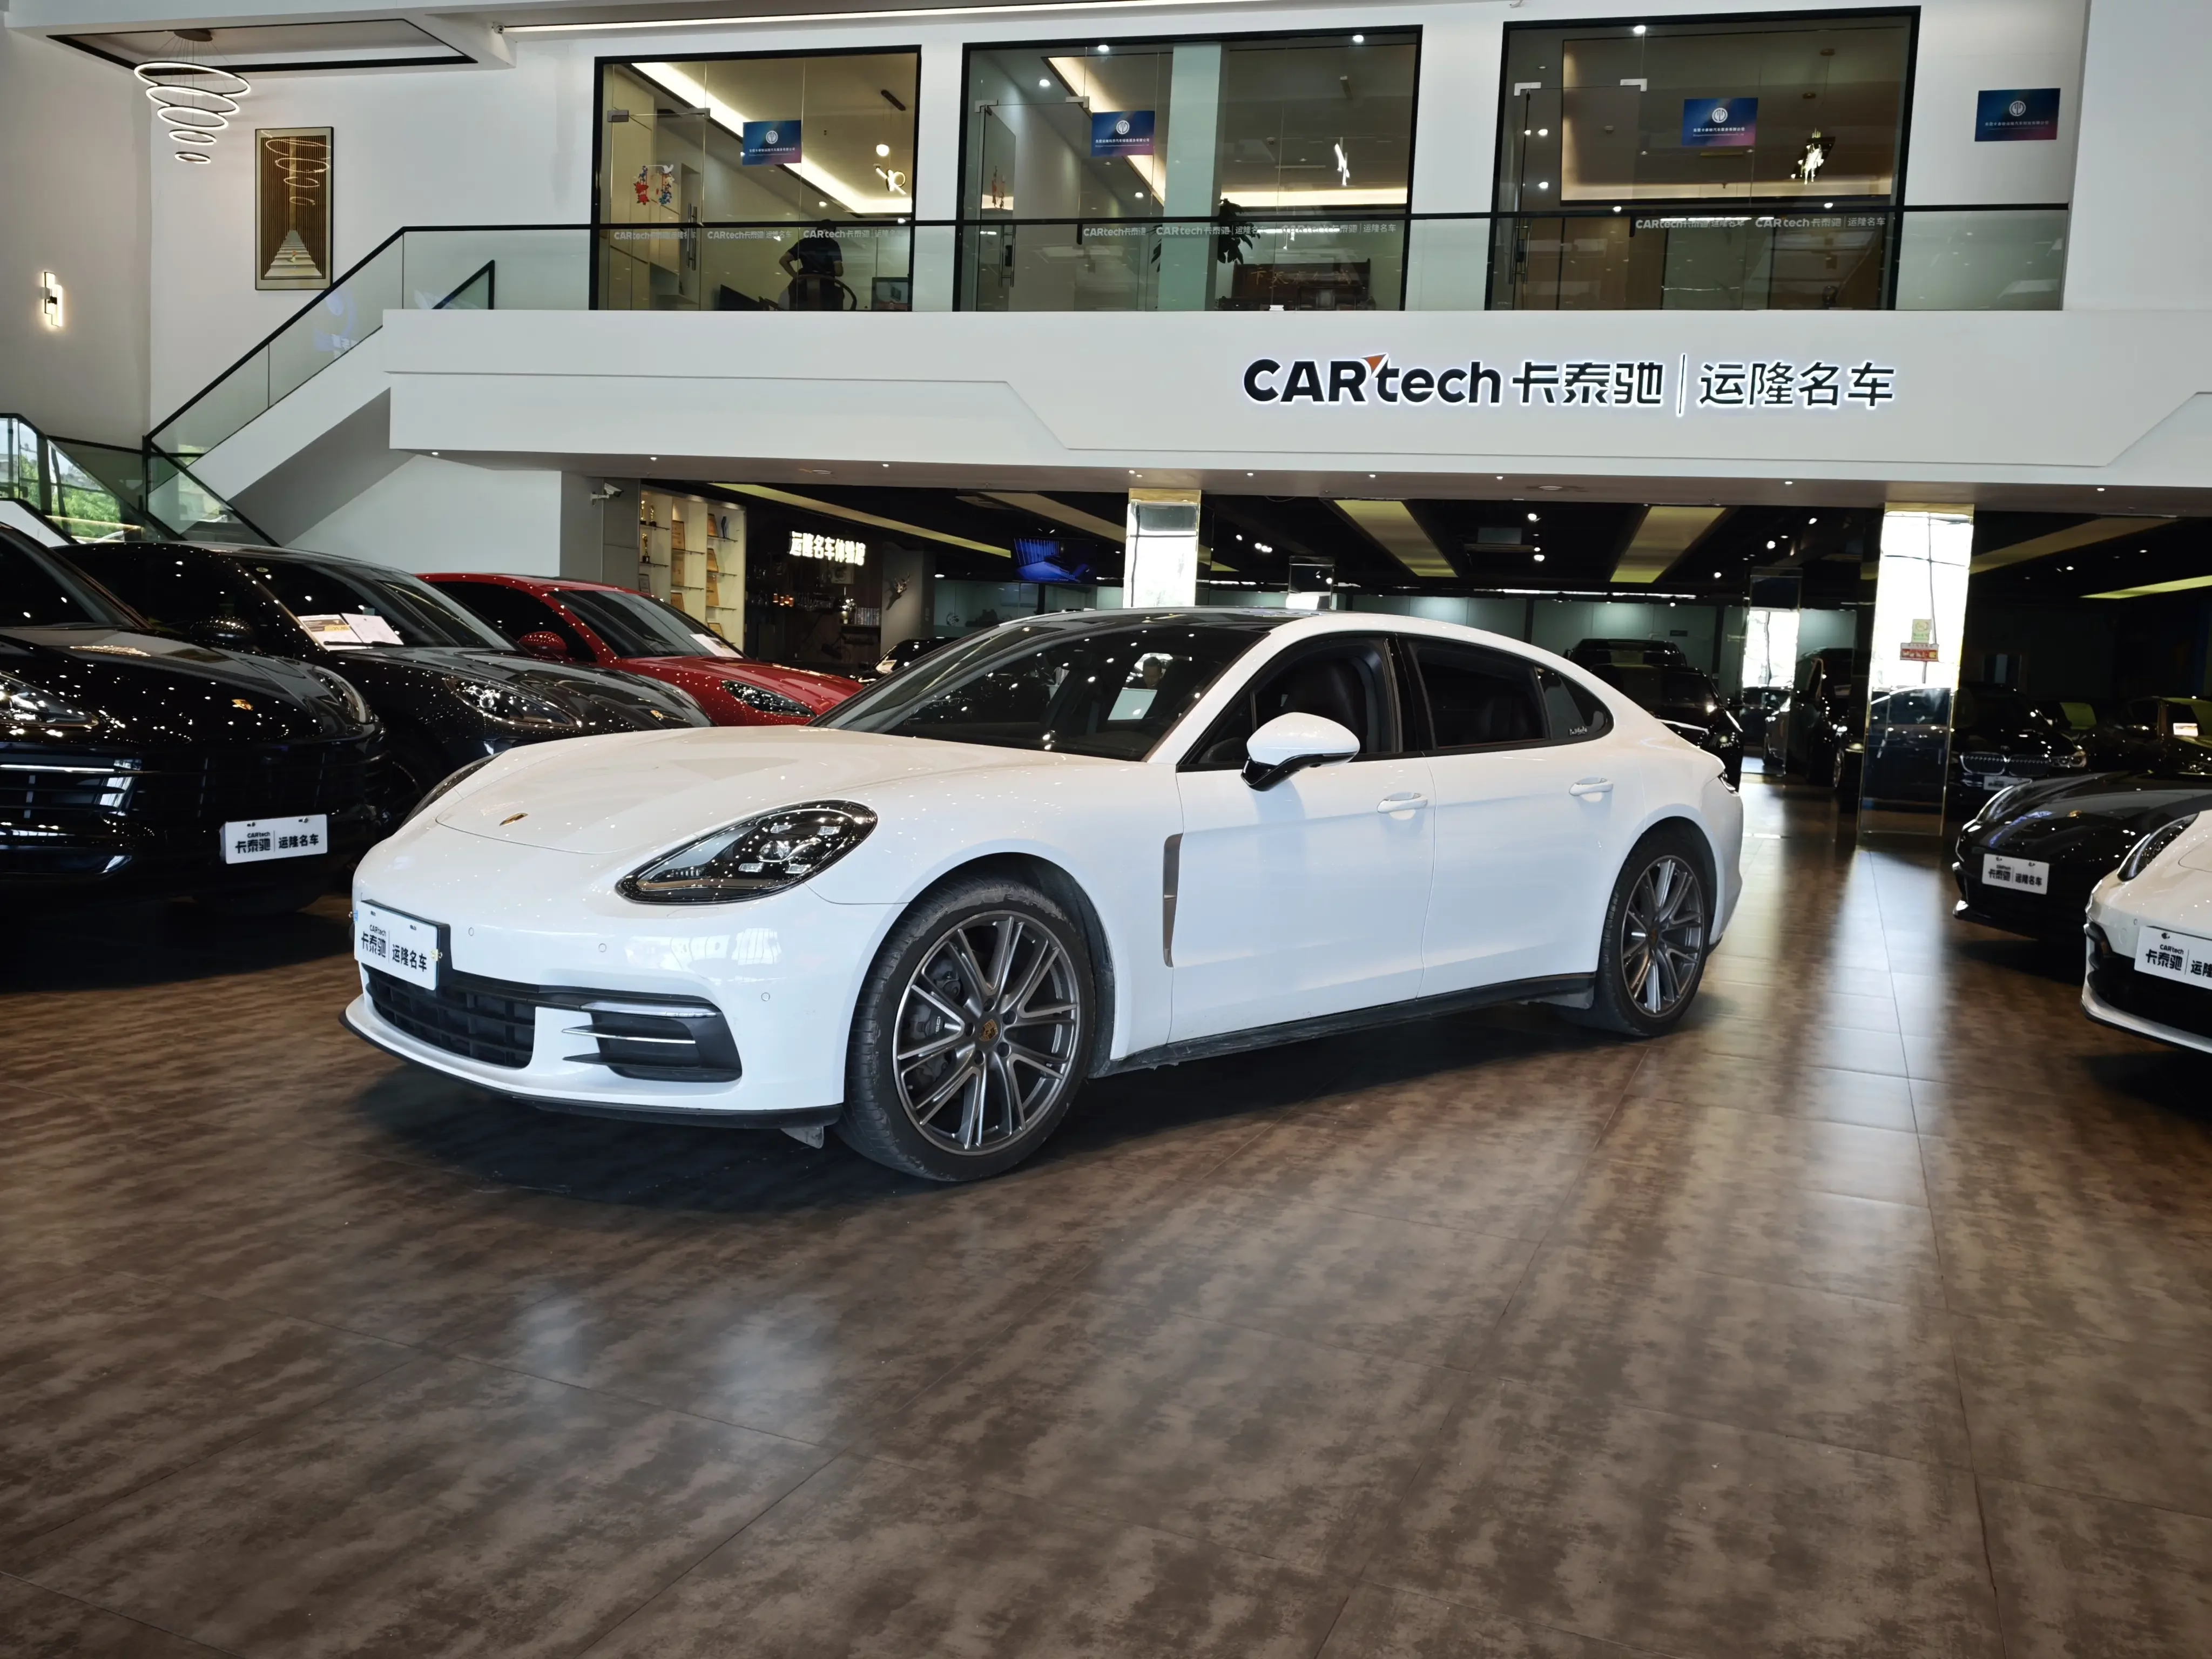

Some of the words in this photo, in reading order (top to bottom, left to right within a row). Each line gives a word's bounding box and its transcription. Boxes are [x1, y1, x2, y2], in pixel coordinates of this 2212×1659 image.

[1755, 218, 1810, 227] CARtech
[1847, 217, 1886, 227] 运隆名车
[803, 230, 845, 238] CARtech
[1083, 228, 1123, 237] CARtech
[1156, 226, 1202, 235] CARtech
[1363, 224, 1397, 233] 运隆名车
[1244, 355, 1501, 403] CARtech
[1512, 361, 1664, 404] 卡泰驰
[1701, 361, 1896, 407] 运隆名车
[235, 838, 271, 854] 卡泰驰
[278, 833, 319, 849] 运隆名车
[369, 924, 387, 937] CARtech
[361, 931, 386, 958] 卡泰驰
[392, 943, 427, 972] 运隆名车
[2160, 944, 2184, 955] CARtech
[2146, 948, 2183, 971] 卡泰驰
